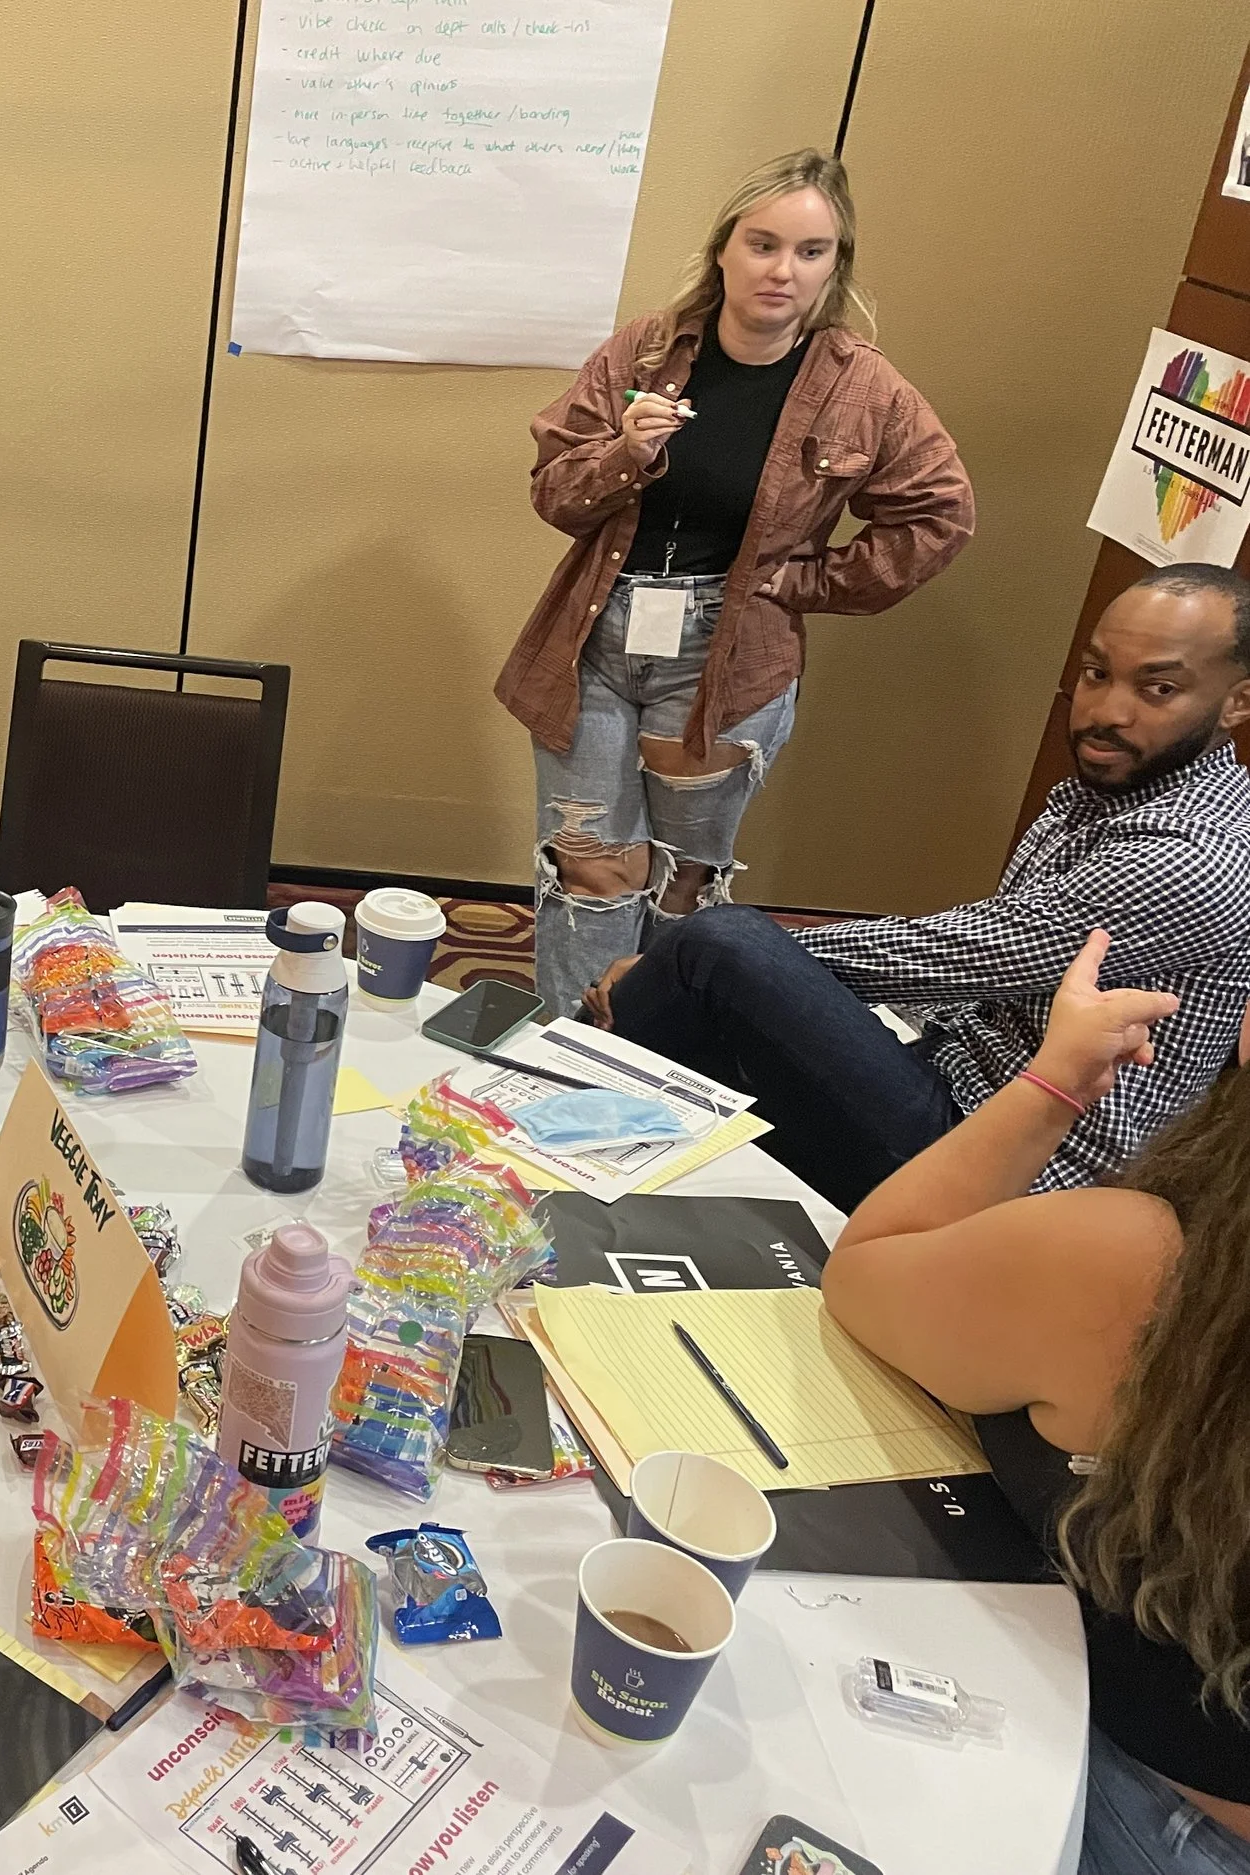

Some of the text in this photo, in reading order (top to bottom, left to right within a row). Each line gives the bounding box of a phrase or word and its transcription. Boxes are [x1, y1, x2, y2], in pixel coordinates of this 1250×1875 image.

[407, 24, 423, 34] on
[415, 49, 442, 66] due
[1146, 406, 1250, 484] FETTERMAN
[83, 1169, 116, 1232] TRAY
[243, 1443, 331, 1473] FETTER
[418, 1533, 458, 1576] OREO
[596, 1685, 656, 1717] Repeat.
[618, 1690, 668, 1709] Savor.
[165, 1764, 225, 1820] Default
[430, 1825, 463, 1860] you
[453, 1780, 500, 1827] listen
